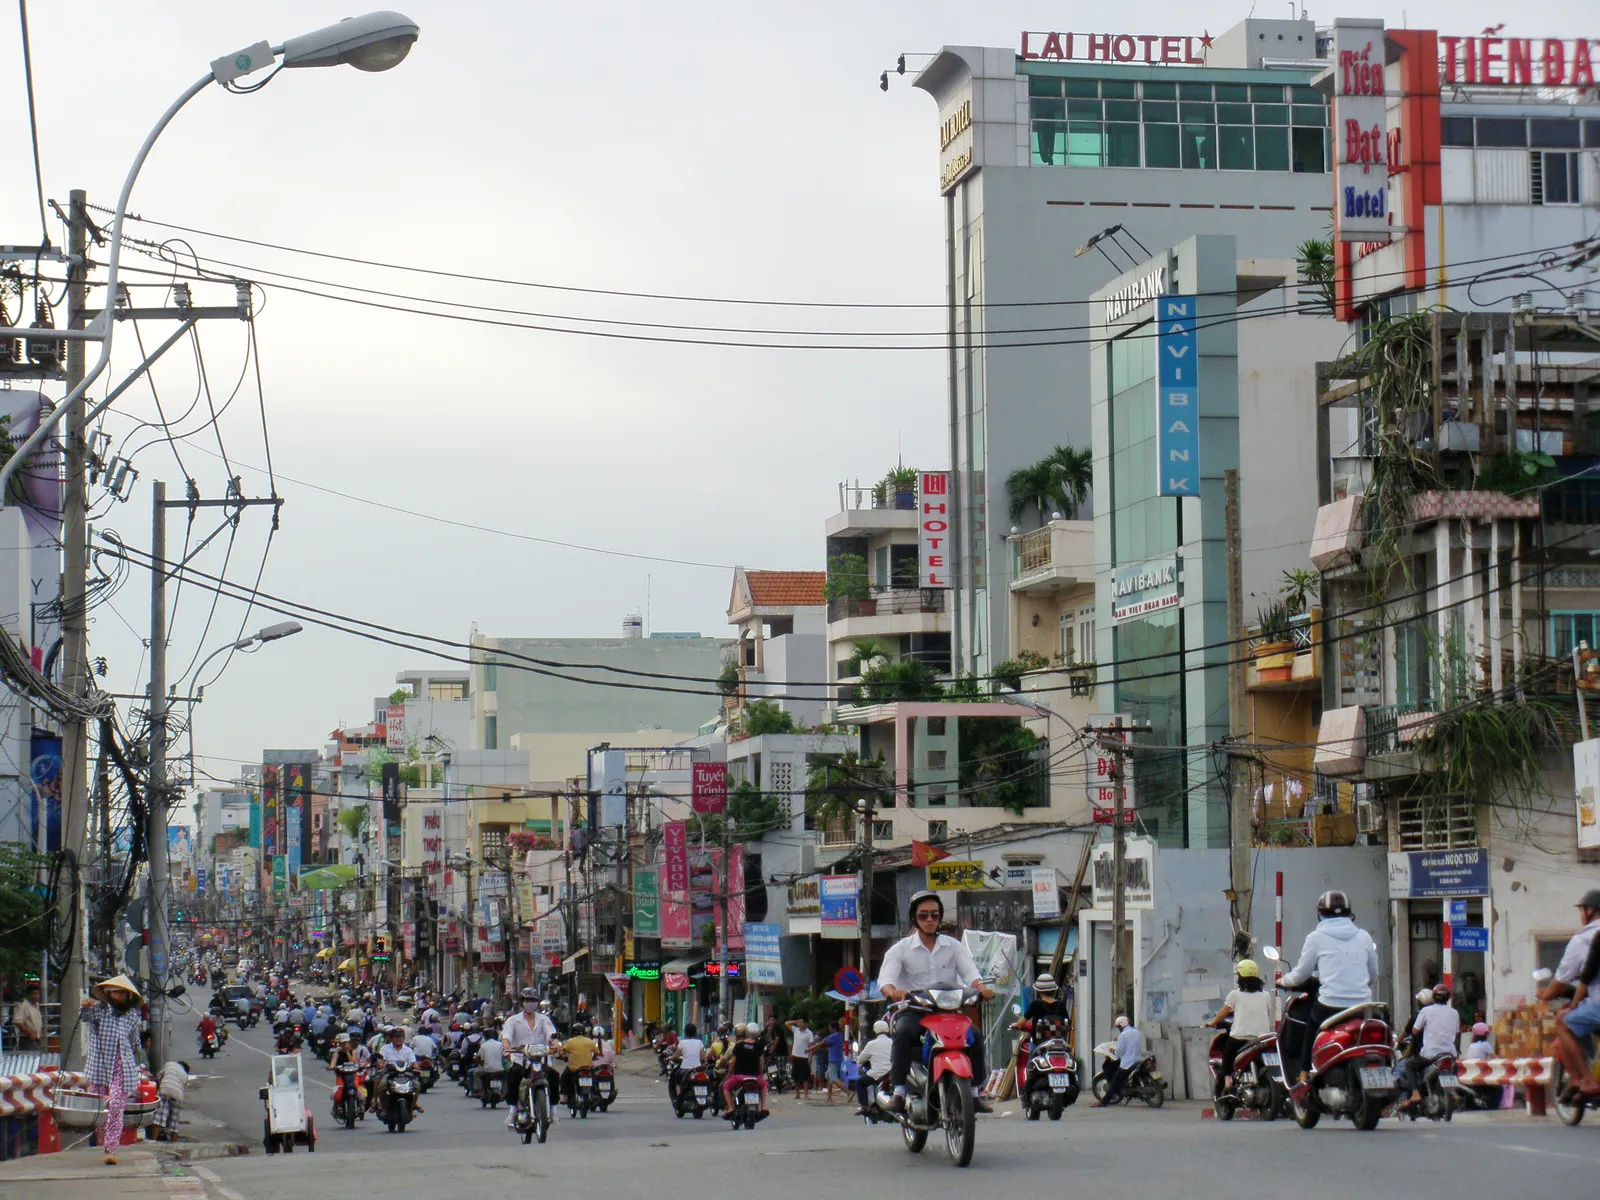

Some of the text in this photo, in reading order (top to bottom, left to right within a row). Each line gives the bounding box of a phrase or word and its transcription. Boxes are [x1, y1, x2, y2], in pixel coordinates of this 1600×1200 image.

[1021, 31, 1204, 64] LAI HOTEL
[1440, 24, 1532, 85] TIẾN
[1344, 118, 1383, 174] Đạt
[1344, 186, 1385, 218] Hotel
[1106, 267, 1165, 323] NAVIBANK
[1168, 303, 1190, 491] NAVIBANK
[924, 503, 947, 585] HOTEL
[1112, 566, 1174, 597] NAVIBANK
[695, 768, 725, 786] Tuyết
[669, 828, 684, 890] VIVABON
[1445, 853, 1464, 867] NGỌC
